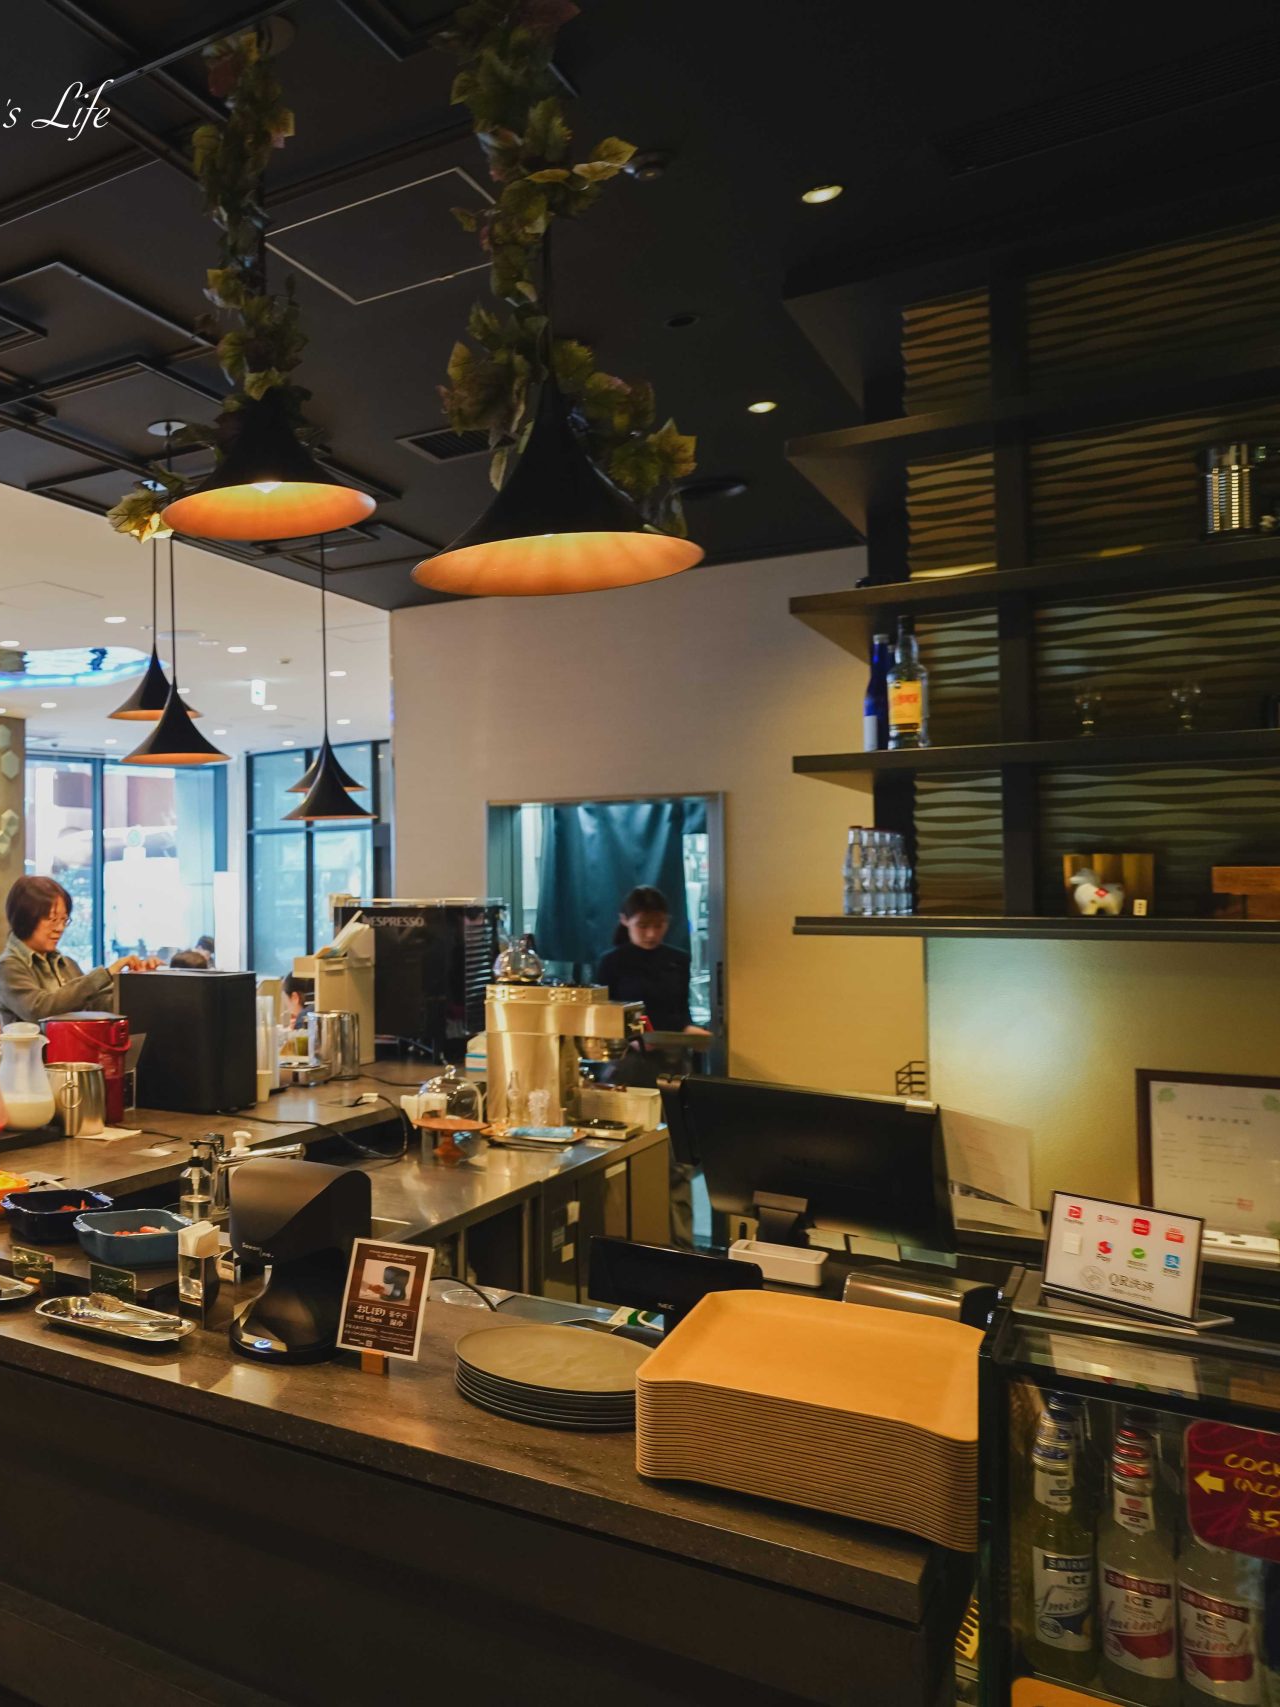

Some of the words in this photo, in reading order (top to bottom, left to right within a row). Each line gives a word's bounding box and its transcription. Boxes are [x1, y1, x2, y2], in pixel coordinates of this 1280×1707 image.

[362, 914, 425, 927] NESPRESSO
[356, 1304, 386, 1317] おしぼり
[1067, 1575, 1087, 1585] ICE
[1107, 1572, 1170, 1595] SMIRNOFF
[1125, 1595, 1153, 1608] ICE
[1196, 1612, 1227, 1629] ICE
